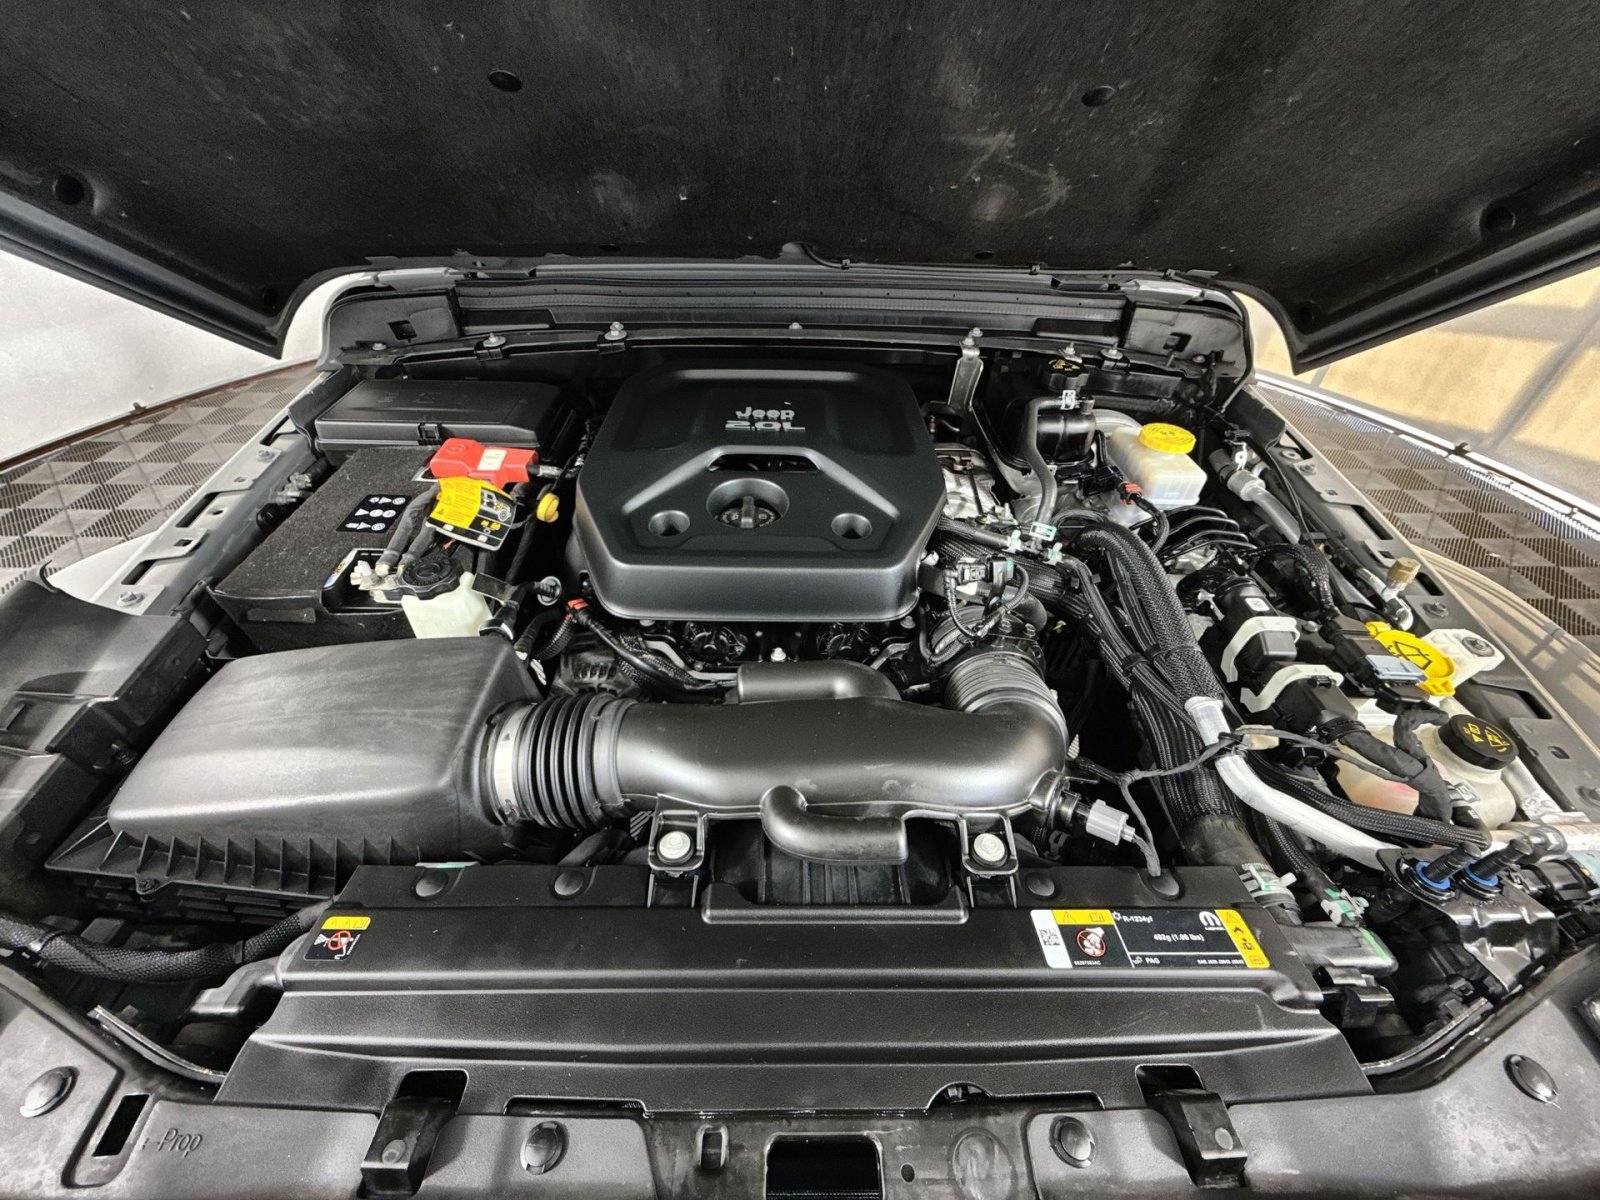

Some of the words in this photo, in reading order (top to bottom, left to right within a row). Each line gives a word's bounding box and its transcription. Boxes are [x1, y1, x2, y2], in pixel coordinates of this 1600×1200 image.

[735, 406, 796, 420] Jeep
[725, 420, 806, 432] 2.0L
[158, 1127, 203, 1159] Prop
